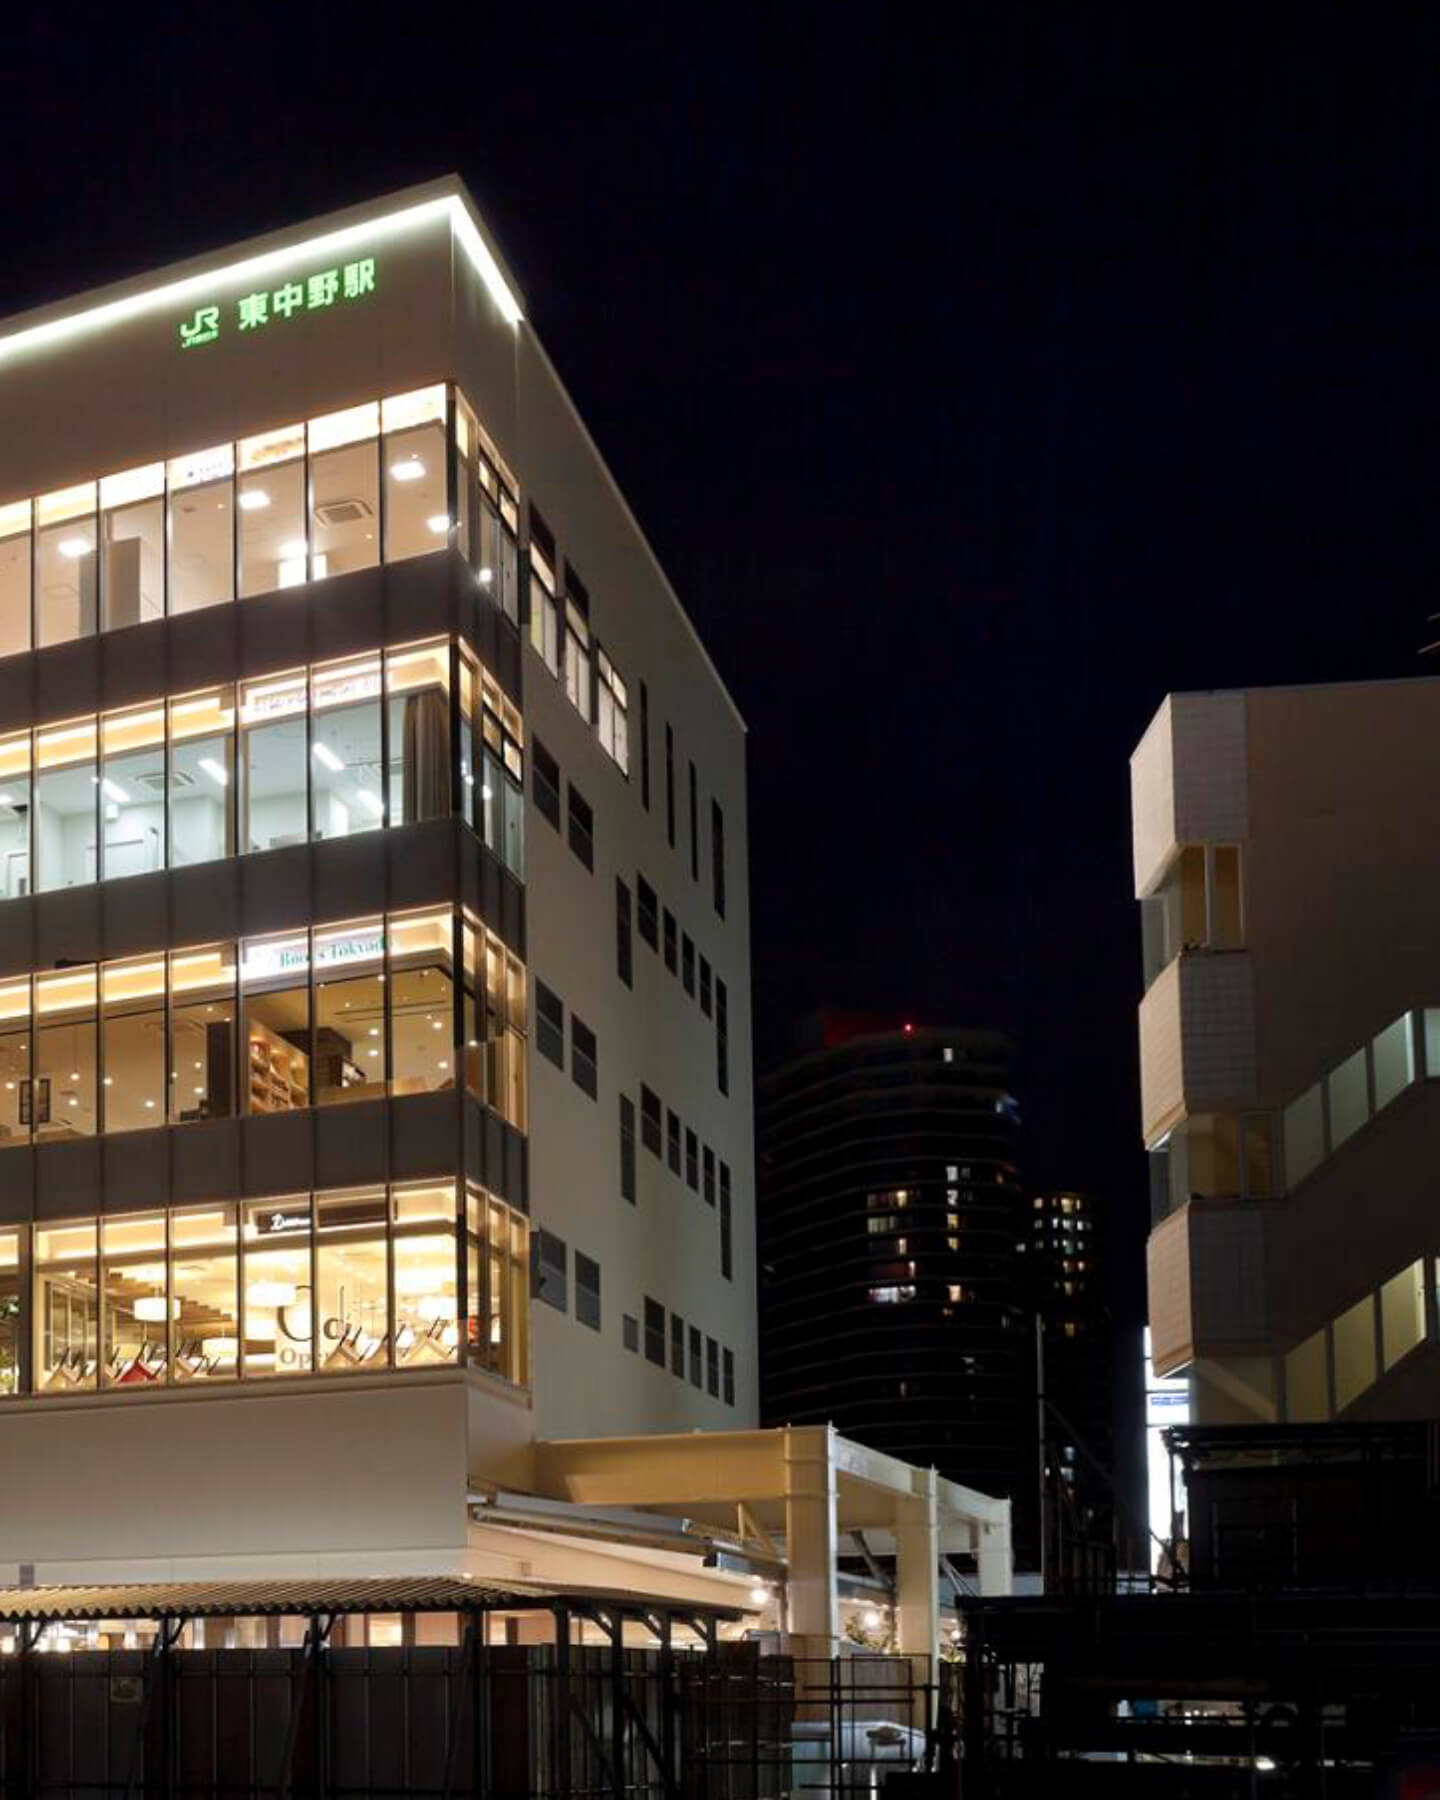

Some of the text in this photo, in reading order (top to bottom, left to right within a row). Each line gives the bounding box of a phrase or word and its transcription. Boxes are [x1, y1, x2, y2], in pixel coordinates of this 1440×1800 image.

[180, 258, 375, 338] JR 東中野駅
